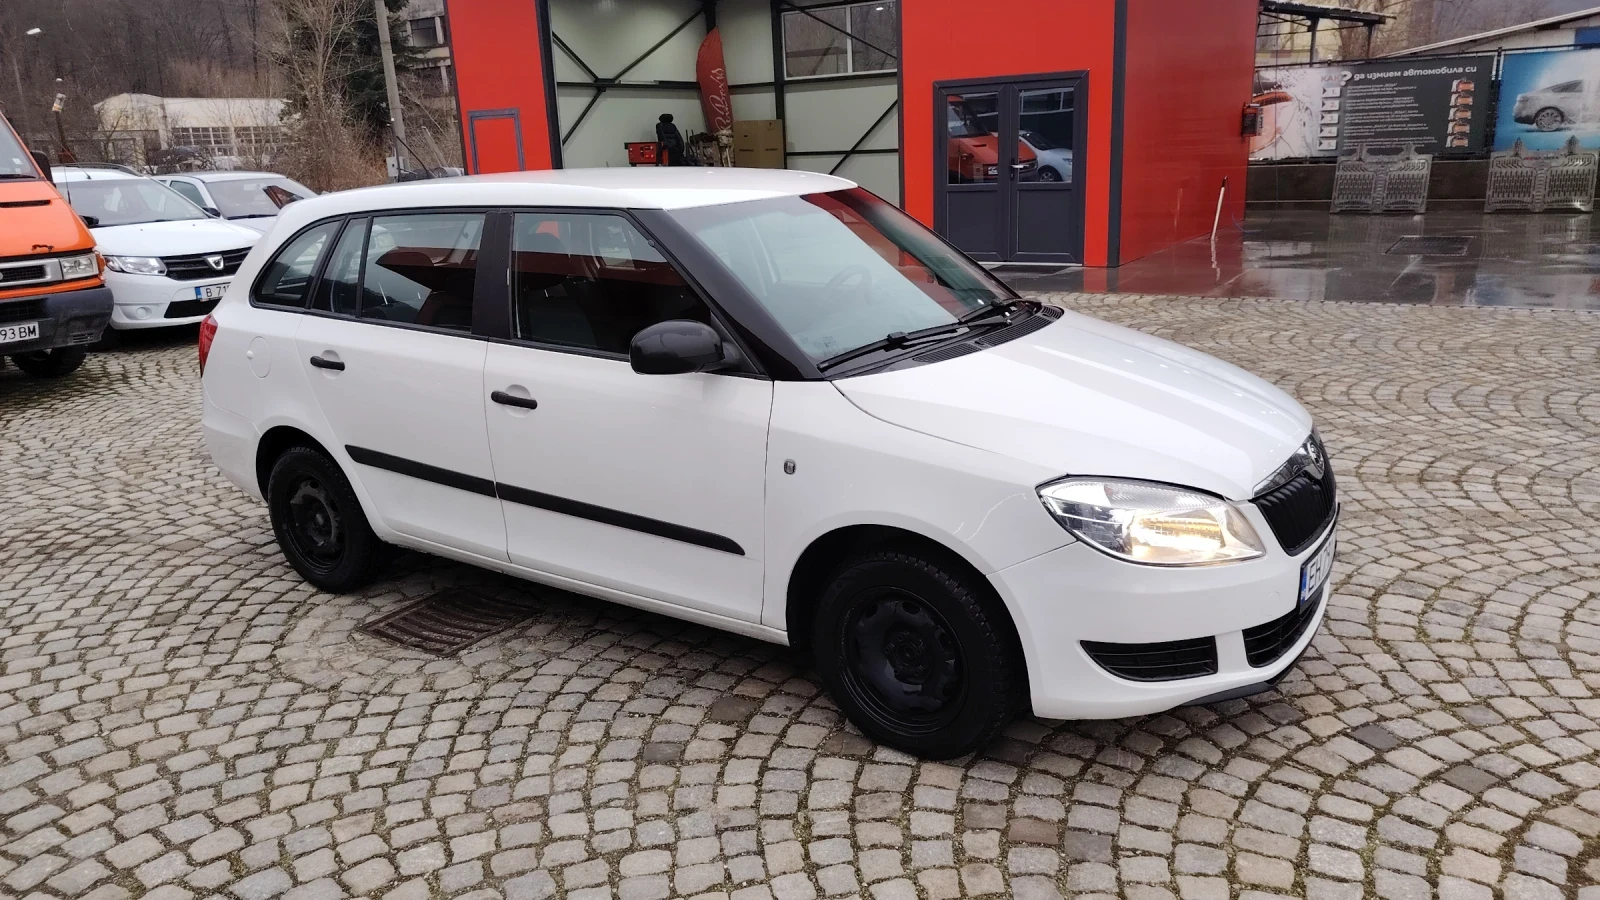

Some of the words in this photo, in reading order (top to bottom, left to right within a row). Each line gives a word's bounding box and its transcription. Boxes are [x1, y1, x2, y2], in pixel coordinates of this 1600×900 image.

[1354, 73, 1365, 81] да
[1366, 71, 1401, 80] измием
[1403, 66, 1464, 77] автомобила
[205, 287, 213, 298] B
[19, 325, 37, 339] BM
